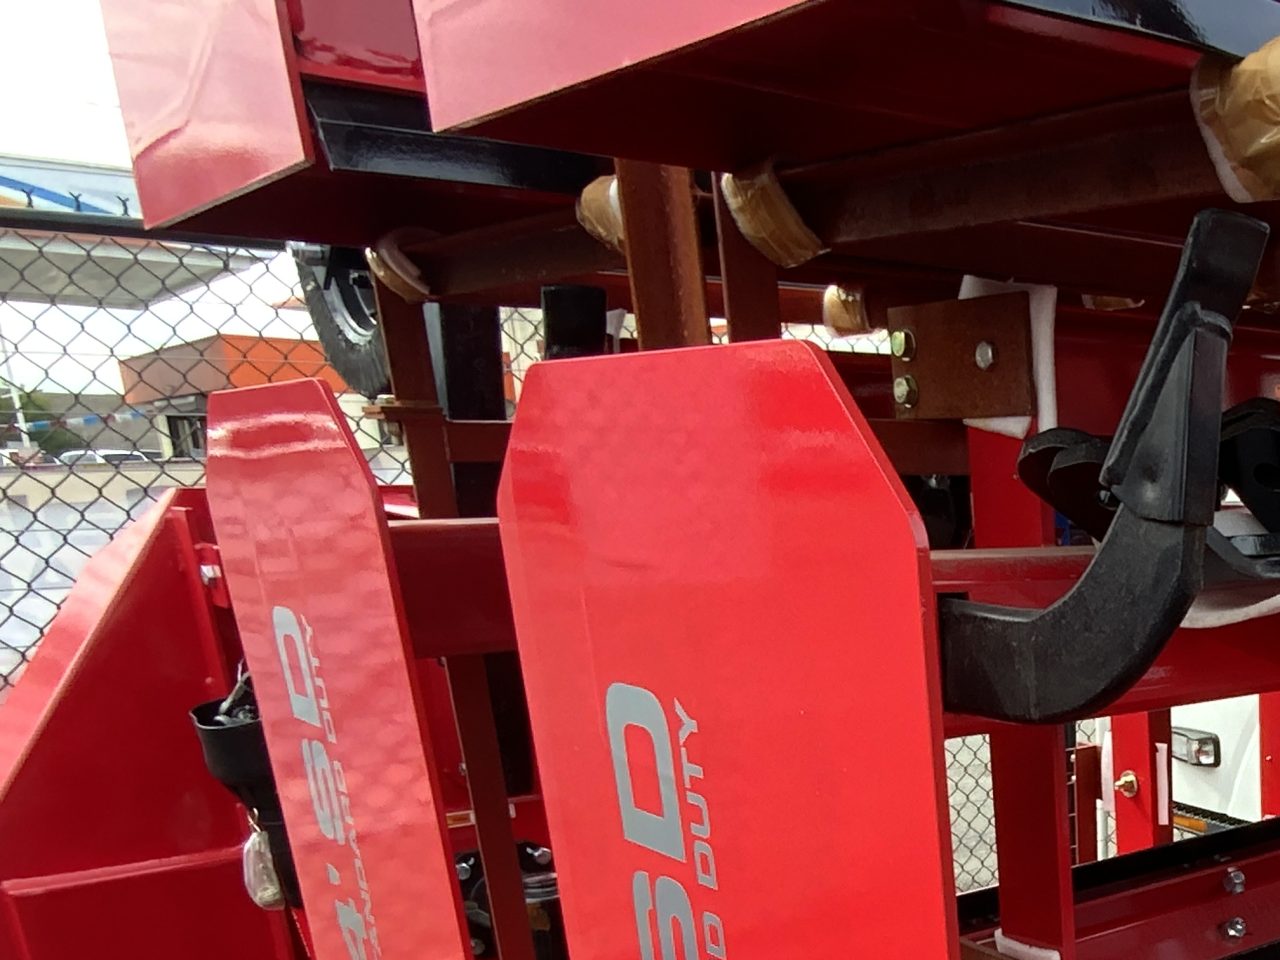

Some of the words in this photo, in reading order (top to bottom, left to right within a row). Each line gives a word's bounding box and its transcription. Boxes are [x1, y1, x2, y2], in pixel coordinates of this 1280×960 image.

[272, 605, 347, 846] SD
[300, 613, 337, 744] DUTY
[673, 696, 719, 891] DUTY
